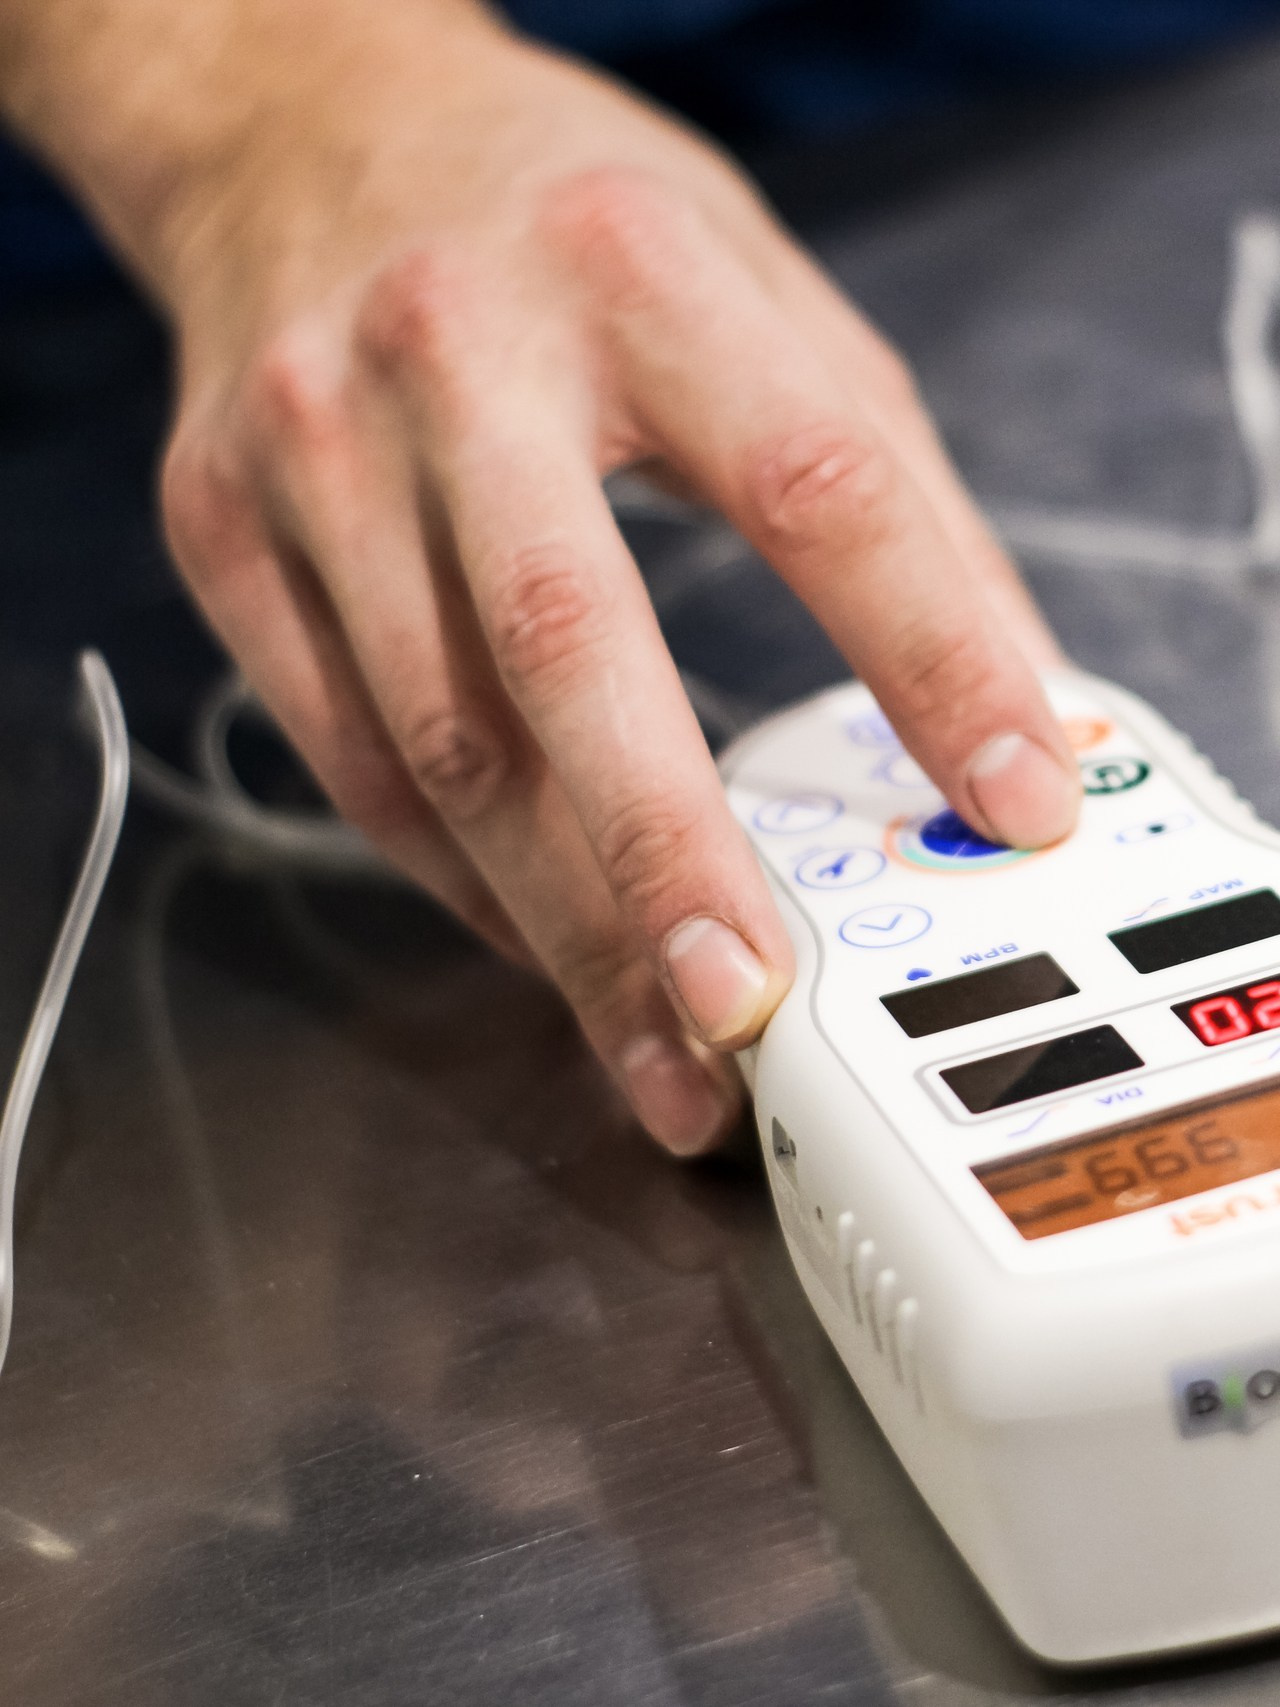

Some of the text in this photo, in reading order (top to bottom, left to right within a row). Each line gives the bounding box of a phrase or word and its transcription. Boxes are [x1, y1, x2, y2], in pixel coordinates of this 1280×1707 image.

[1187, 877, 1244, 901] MAP
[959, 941, 1020, 966] BPM
[1096, 1086, 1144, 1107] DIA
